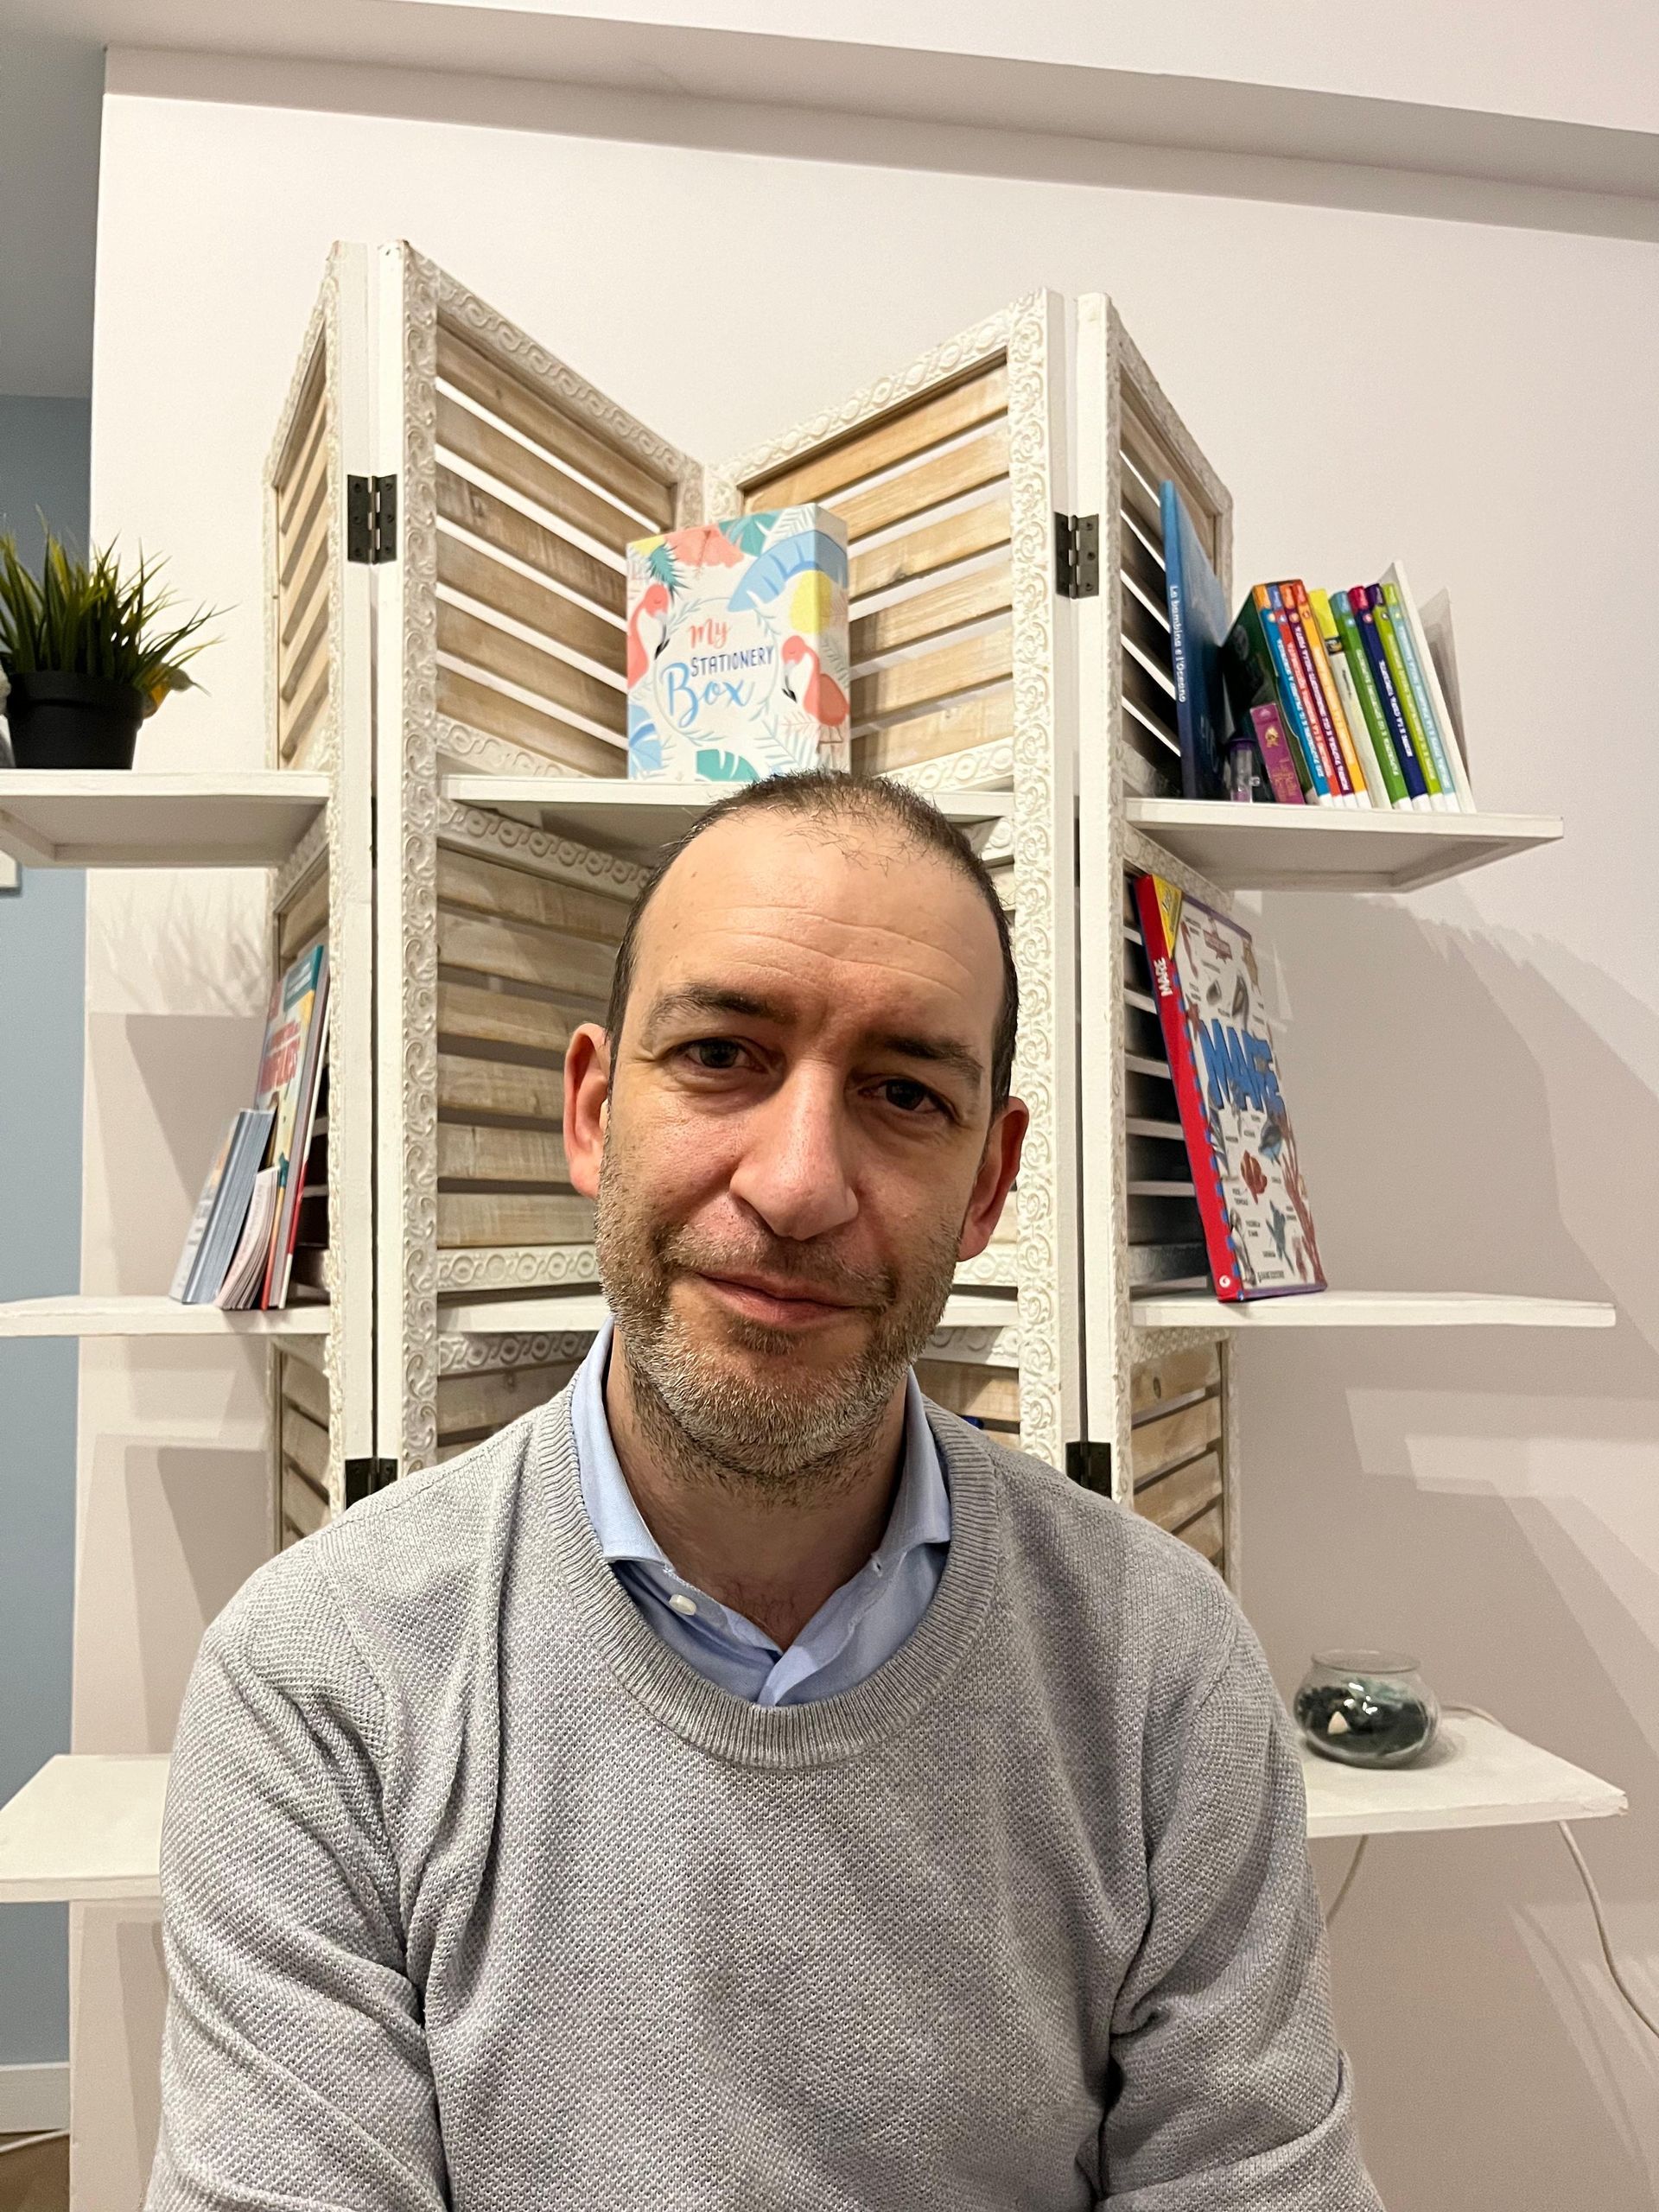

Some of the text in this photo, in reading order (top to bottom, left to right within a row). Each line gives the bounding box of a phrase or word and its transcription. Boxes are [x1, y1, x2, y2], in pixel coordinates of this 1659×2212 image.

[1170, 586, 1179, 598] La
[689, 619, 728, 649] My
[1171, 601, 1182, 647] bambina
[690, 645, 773, 677] STATIONERY
[1176, 658, 1186, 702] l'Oceano
[662, 662, 755, 728] Box
[1154, 957, 1173, 996] MARE
[1198, 1019, 1286, 1115] MARE
